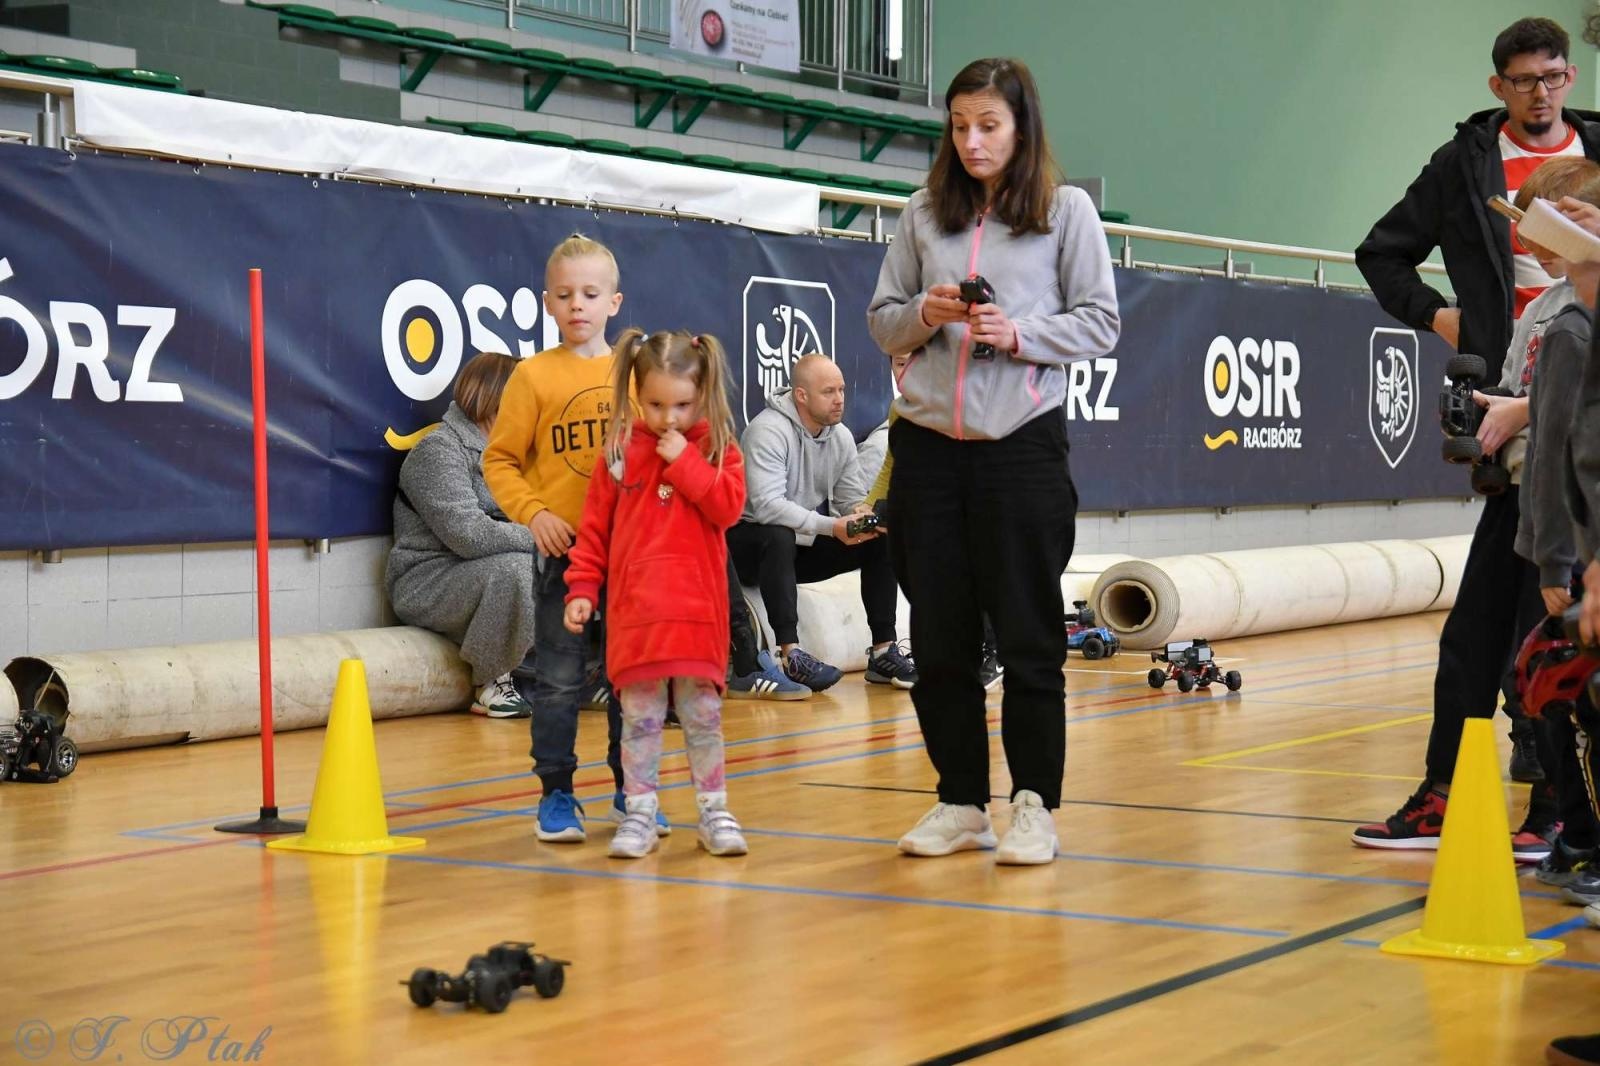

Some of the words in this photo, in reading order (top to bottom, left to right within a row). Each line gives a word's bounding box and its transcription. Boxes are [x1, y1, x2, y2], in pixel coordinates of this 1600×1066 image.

[1062, 357, 1120, 422] RZ
[1203, 335, 1301, 419] OSiR
[1243, 421, 1302, 448] RACIBÓRZ
